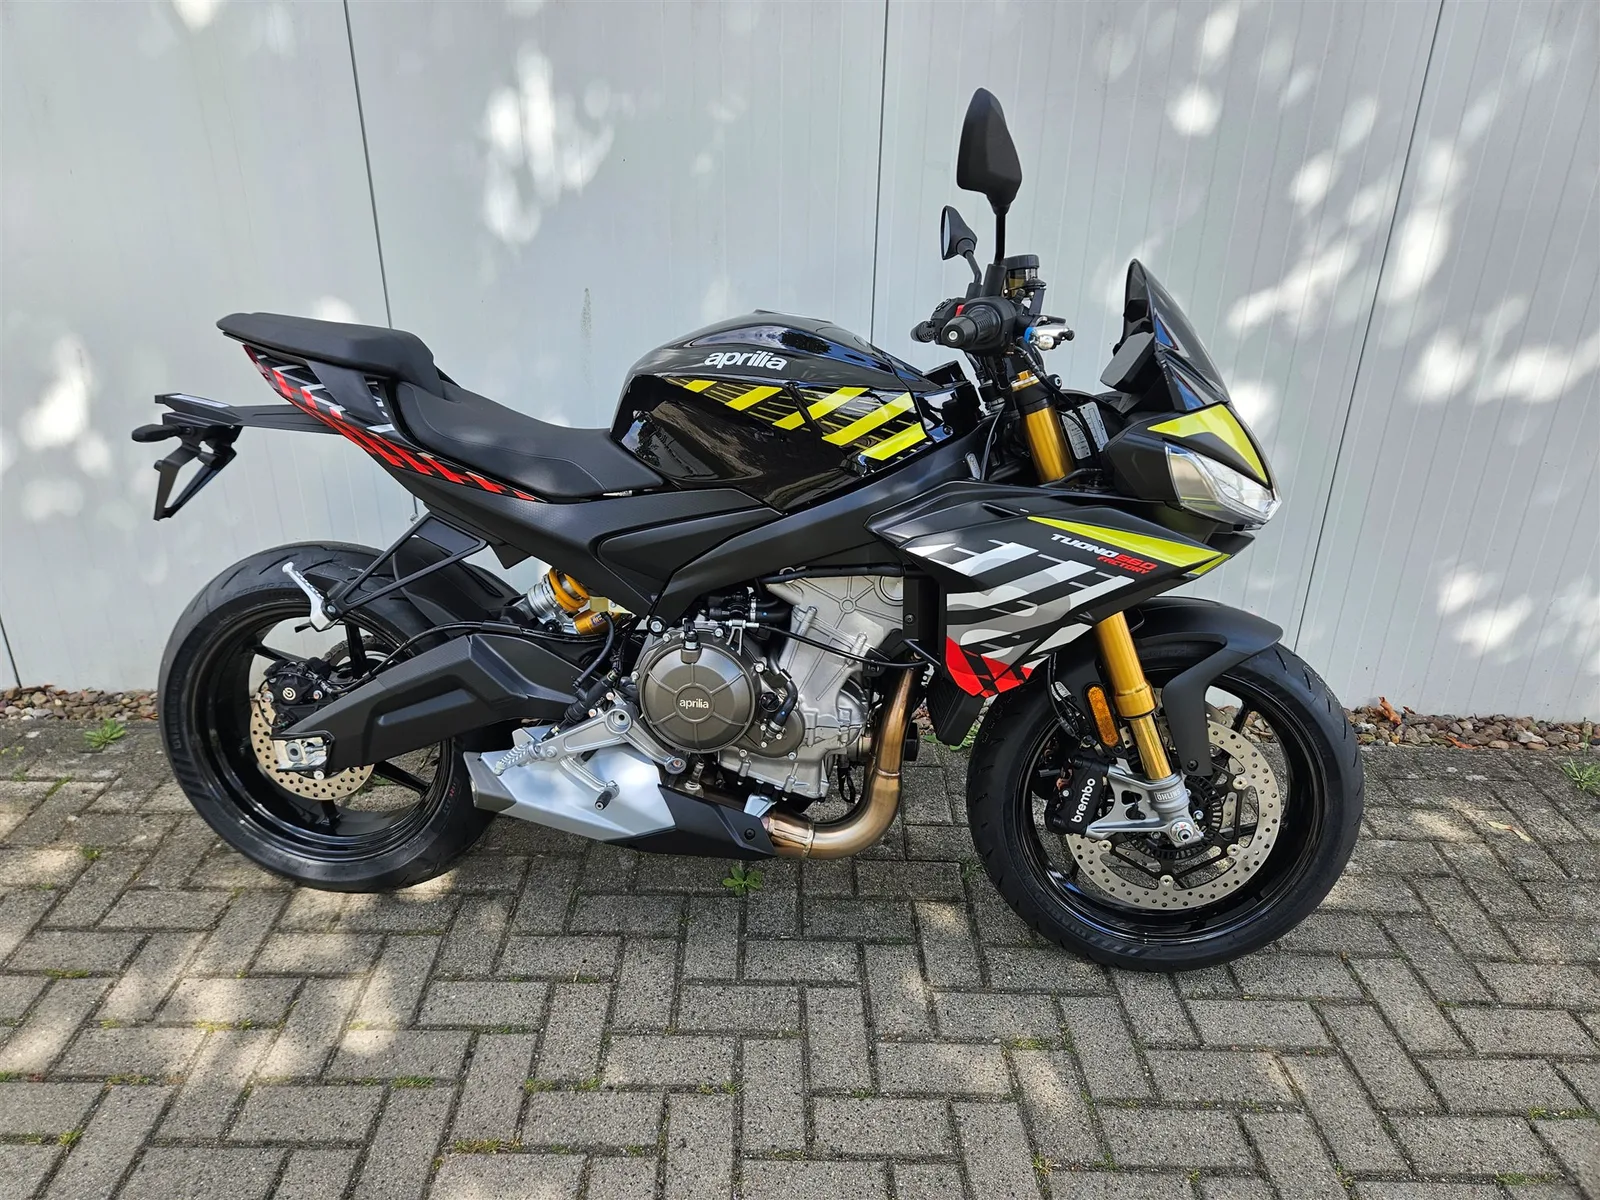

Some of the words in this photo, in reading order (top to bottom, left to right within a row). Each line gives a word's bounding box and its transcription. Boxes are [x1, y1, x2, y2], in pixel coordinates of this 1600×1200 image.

[704, 350, 787, 371] aprilia
[1097, 556, 1150, 574] FACTORY
[679, 698, 709, 709] aprilia
[1071, 778, 1096, 823] brembo
